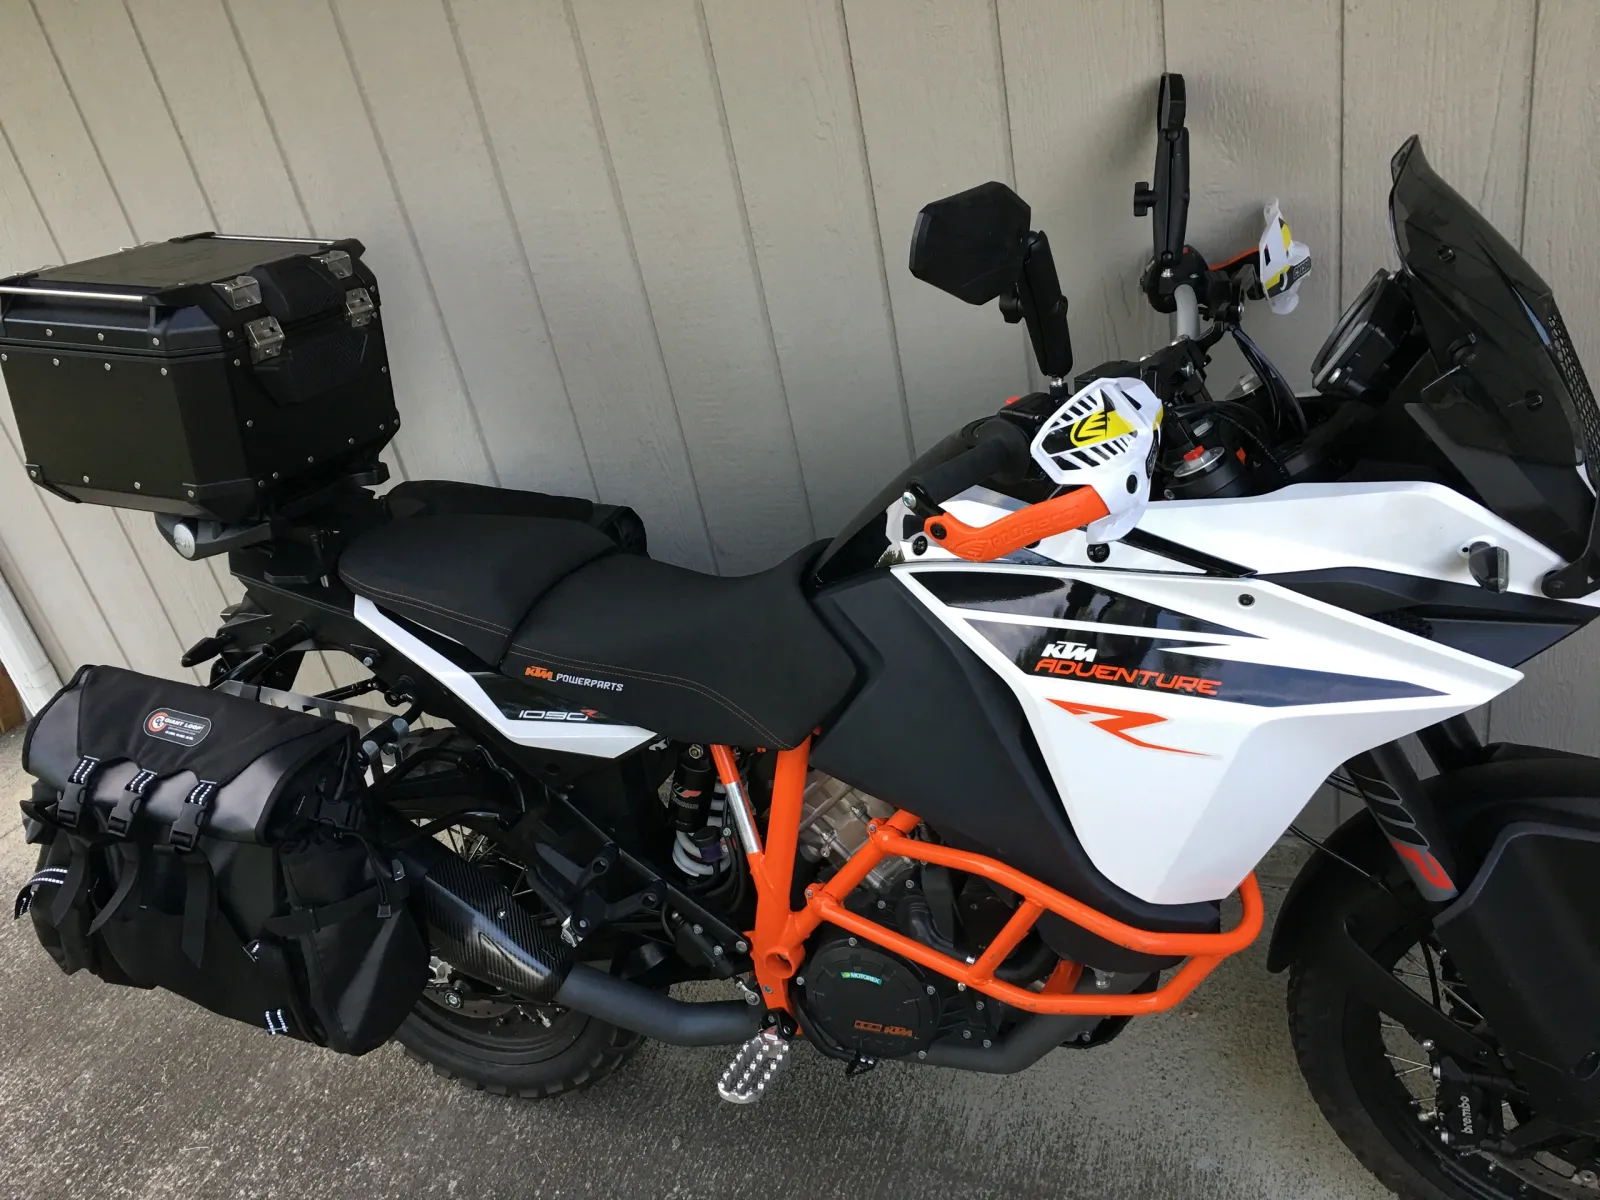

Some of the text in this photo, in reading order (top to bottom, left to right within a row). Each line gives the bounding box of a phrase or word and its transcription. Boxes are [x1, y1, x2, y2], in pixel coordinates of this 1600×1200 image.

[1041, 641, 1097, 662] KTM
[524, 665, 553, 681] KTM
[1034, 659, 1222, 696] ADVENTURE
[164, 717, 184, 727] GIANT
[519, 710, 588, 721] 1090
[850, 972, 881, 985] MOTOREX
[1458, 1095, 1474, 1134] brembo
